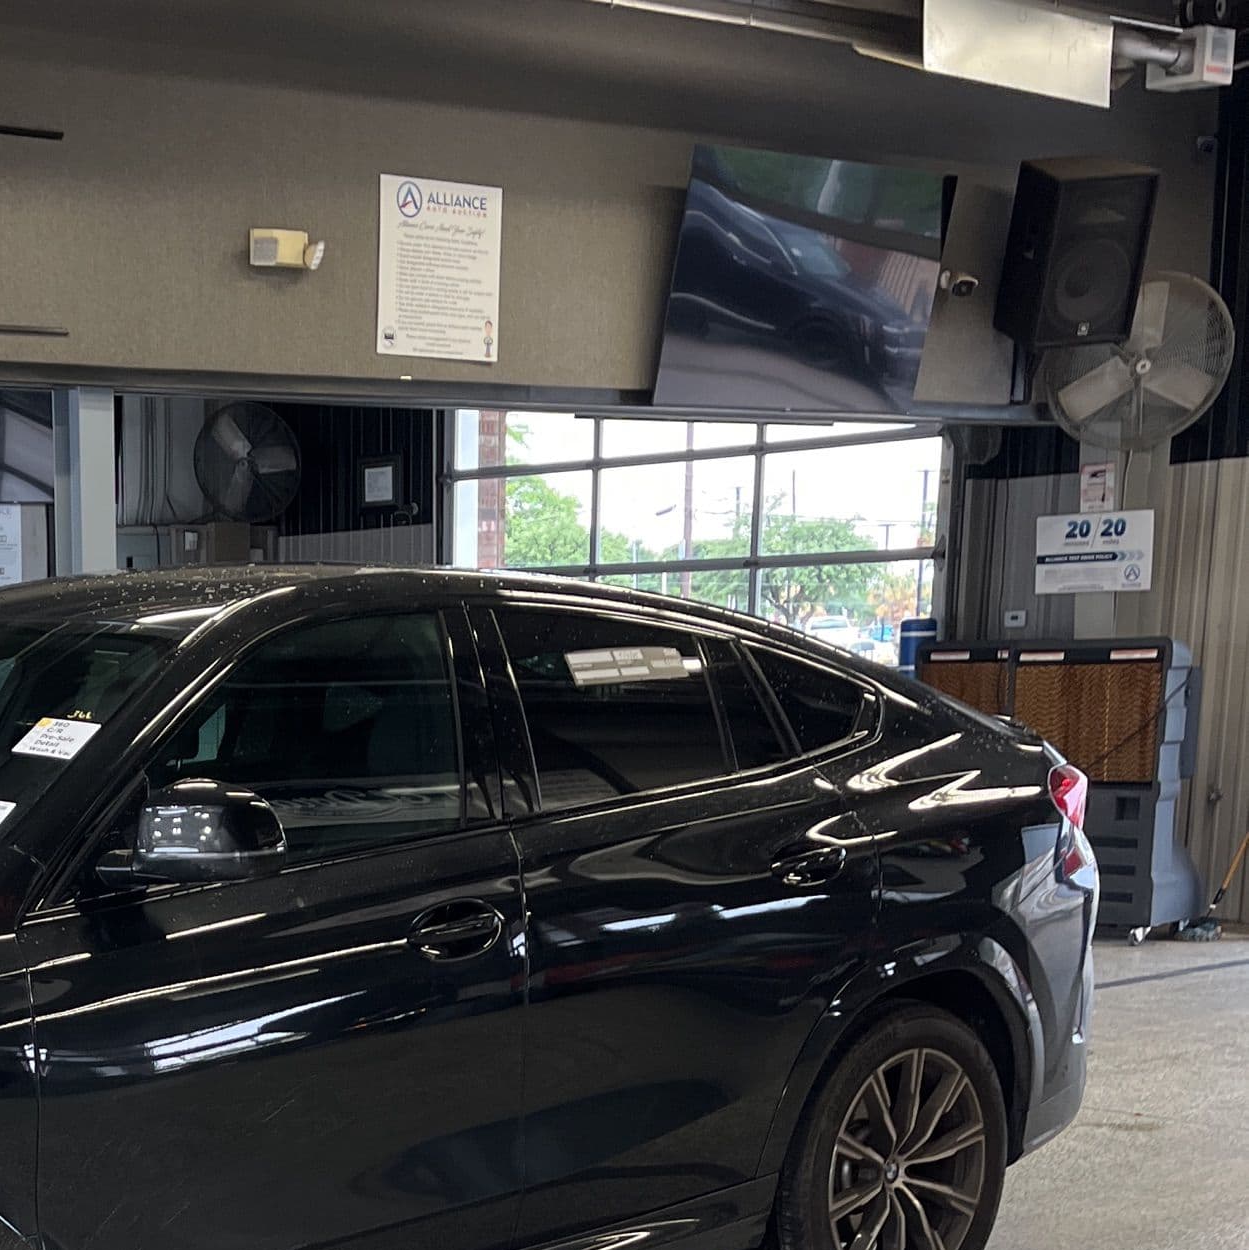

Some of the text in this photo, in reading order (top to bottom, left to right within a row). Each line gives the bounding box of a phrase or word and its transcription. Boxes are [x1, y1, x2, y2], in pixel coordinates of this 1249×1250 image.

[427, 191, 487, 210] ALLIANCE
[1065, 518, 1127, 539] 20 20
